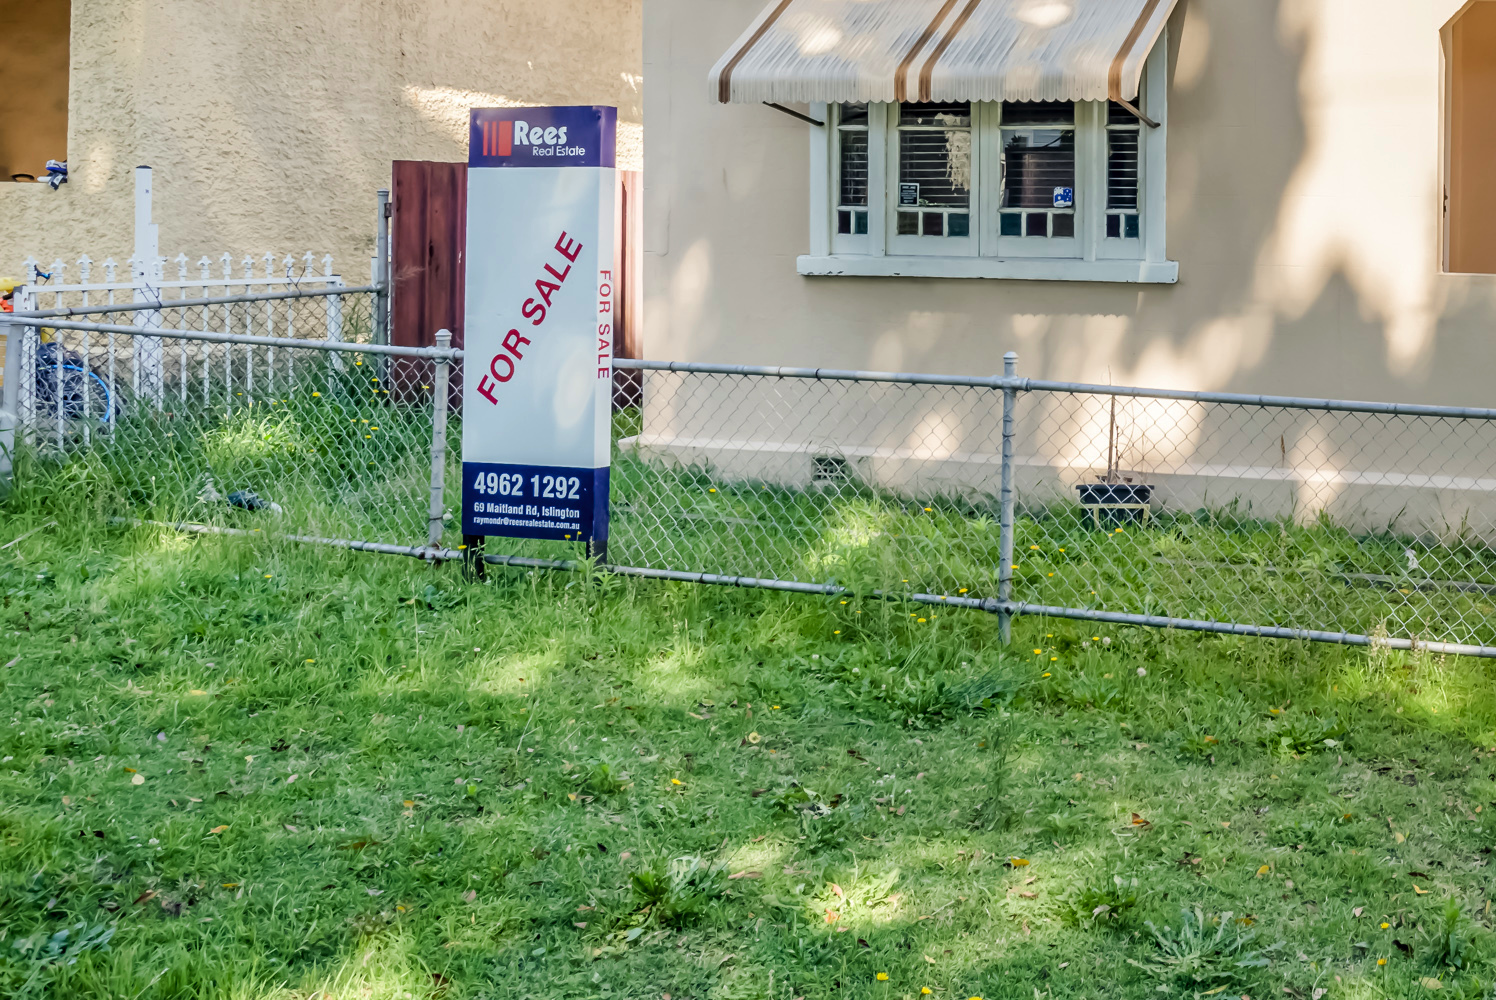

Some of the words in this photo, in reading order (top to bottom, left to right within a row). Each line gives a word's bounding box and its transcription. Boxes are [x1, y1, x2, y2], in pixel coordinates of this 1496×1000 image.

[514, 120, 567, 145] Rees
[532, 146, 554, 156] Real
[556, 146, 586, 156] Estate
[599, 270, 611, 314] FOR
[476, 328, 532, 406] FOR
[521, 230, 583, 326] SALE
[597, 323, 610, 379] SALE
[473, 472, 523, 496] 4962
[530, 474, 580, 499] 1292
[473, 502, 485, 512] 69
[486, 503, 524, 515] Maitland
[525, 505, 540, 517] Rd,
[541, 506, 580, 519] Islington
[473, 516, 580, 530] raymondr@reesrealestate.com.au
